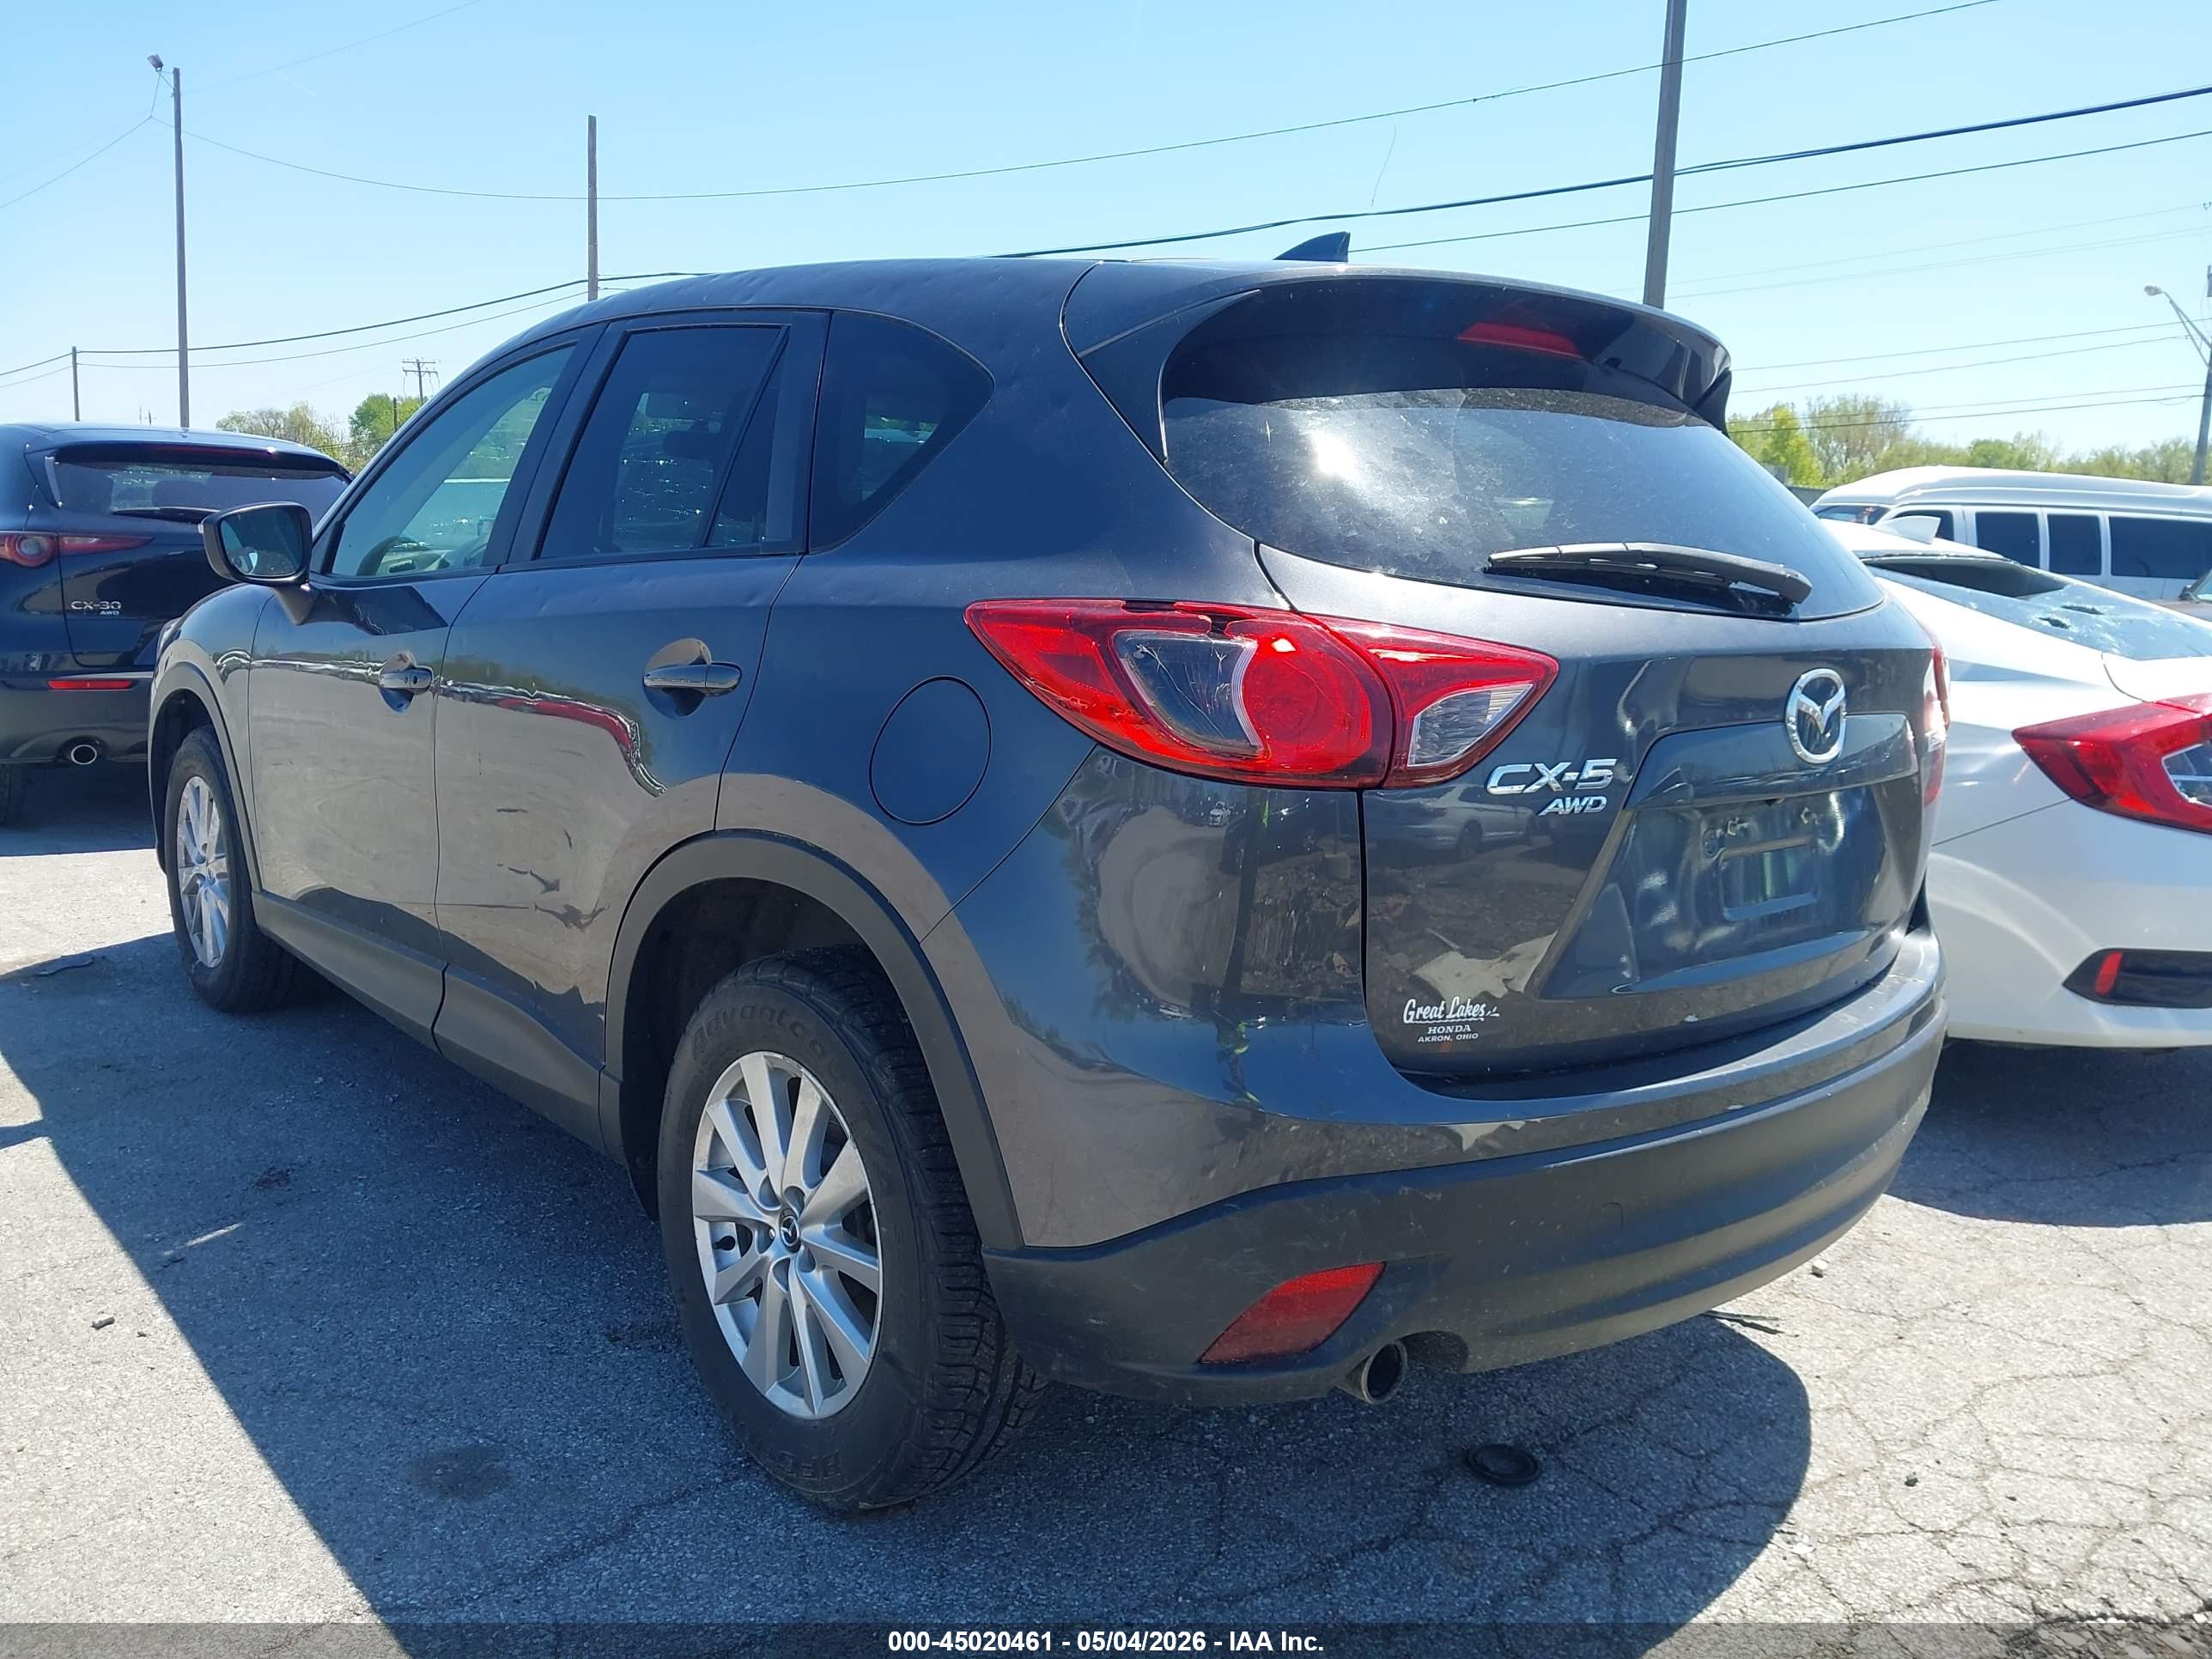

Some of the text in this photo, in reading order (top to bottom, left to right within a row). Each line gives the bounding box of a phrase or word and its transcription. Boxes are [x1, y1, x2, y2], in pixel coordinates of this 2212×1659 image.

[70, 600, 122, 610] CX-30
[1486, 758, 1618, 795] CX-5
[1538, 795, 1607, 816] AWD
[1403, 996, 1486, 1024] Great Lakes
[1417, 1032, 1479, 1043] AKRON, OHIO
[1427, 1024, 1472, 1035] HONDA
